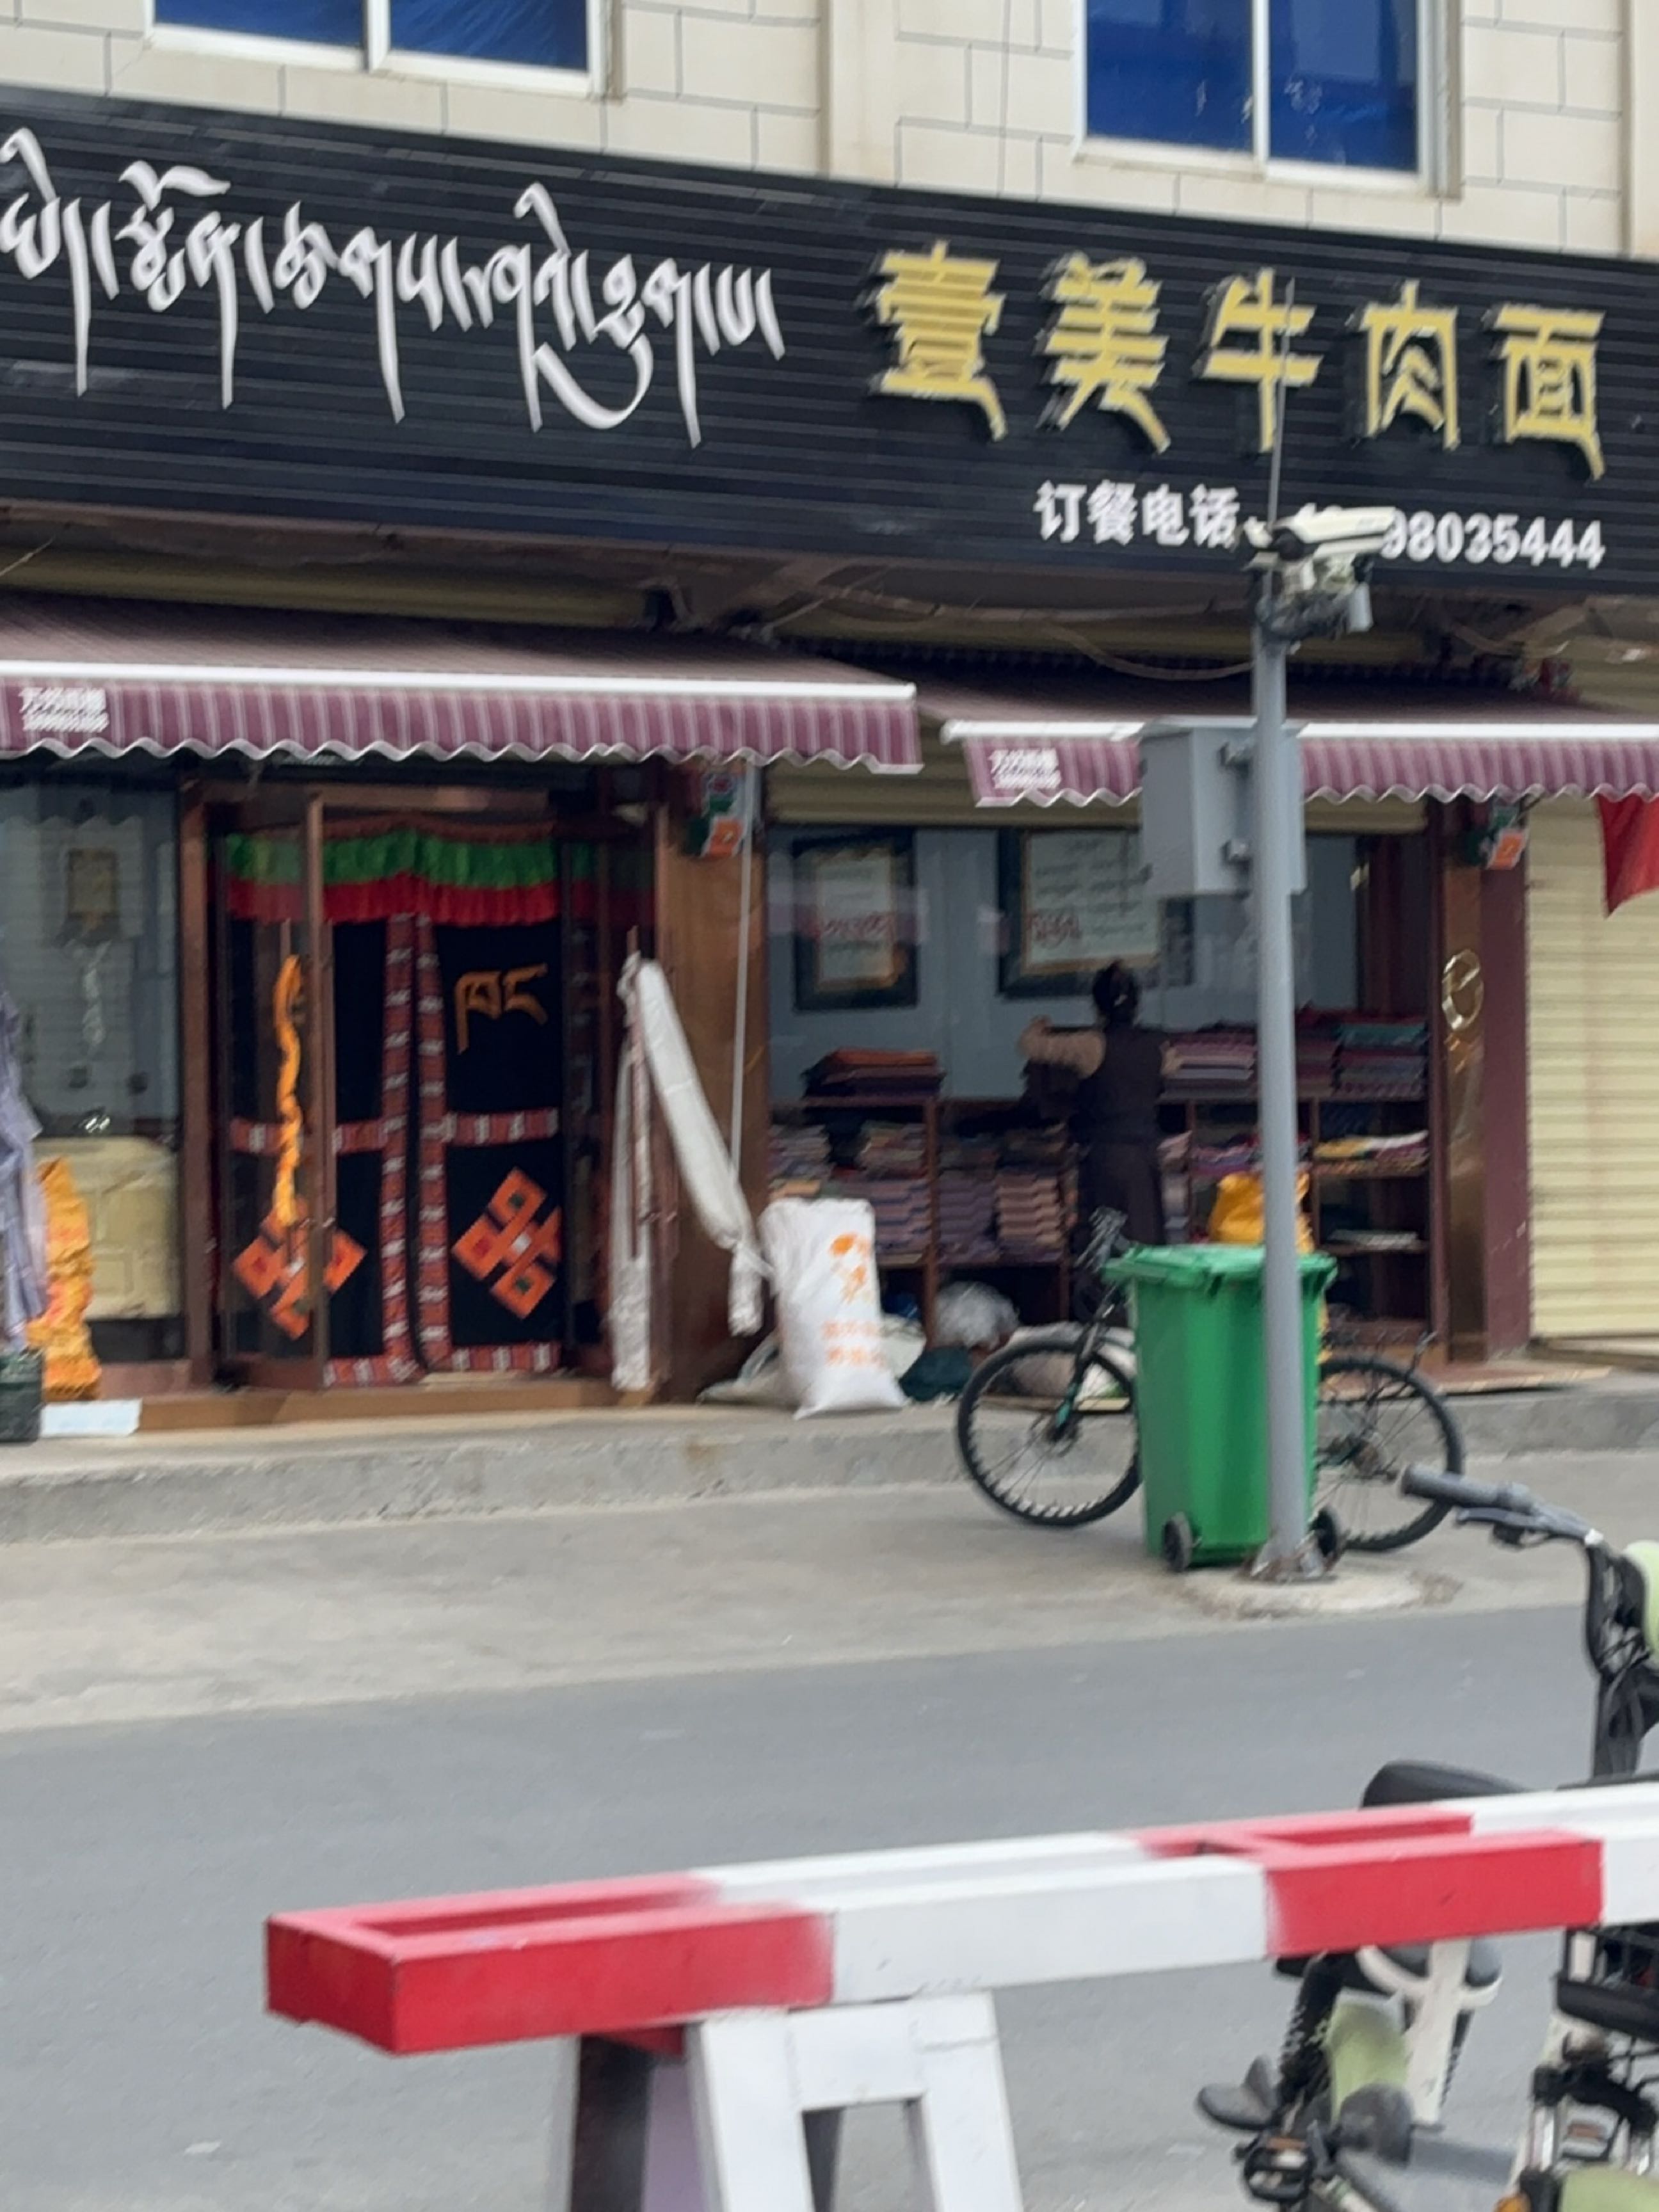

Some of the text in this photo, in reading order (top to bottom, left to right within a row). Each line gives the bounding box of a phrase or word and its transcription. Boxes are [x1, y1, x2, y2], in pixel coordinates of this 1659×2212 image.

[874, 239, 1605, 480] 壹美牛肉面
[1033, 479, 1606, 570] 订餐电话 98035444
